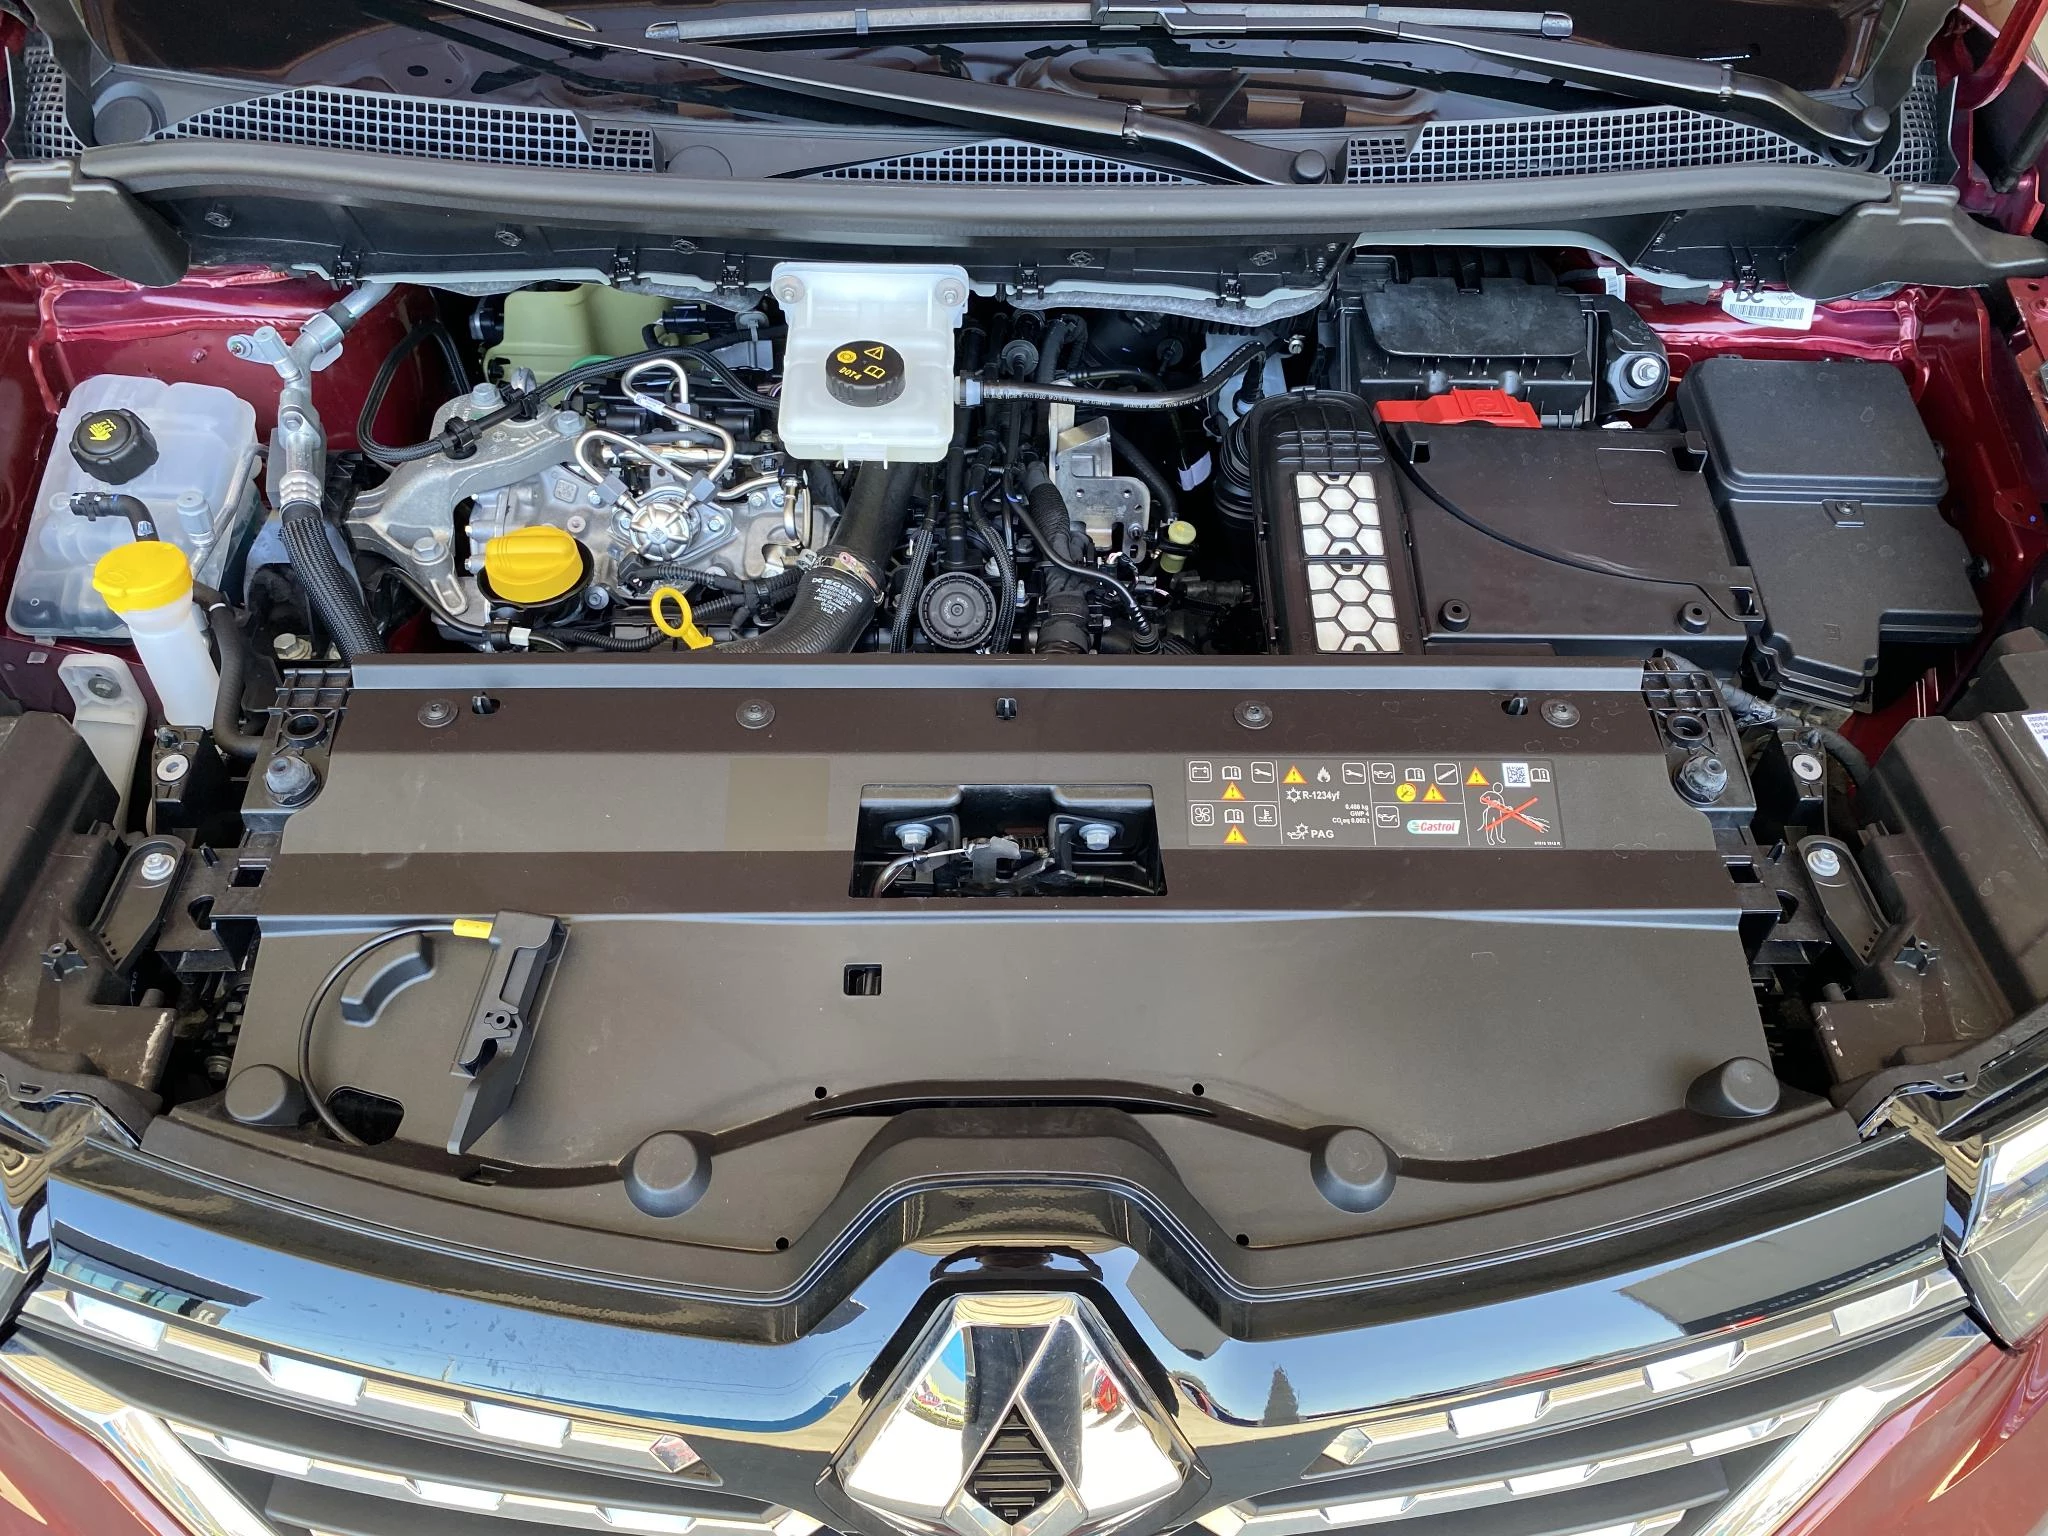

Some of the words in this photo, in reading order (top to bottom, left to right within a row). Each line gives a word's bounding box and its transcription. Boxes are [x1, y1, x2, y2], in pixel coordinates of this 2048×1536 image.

[1302, 790, 1340, 802] R-1234yf
[1361, 803, 1369, 811] kg
[1420, 822, 1456, 832] Castrol
[1311, 830, 1335, 839] PAG
